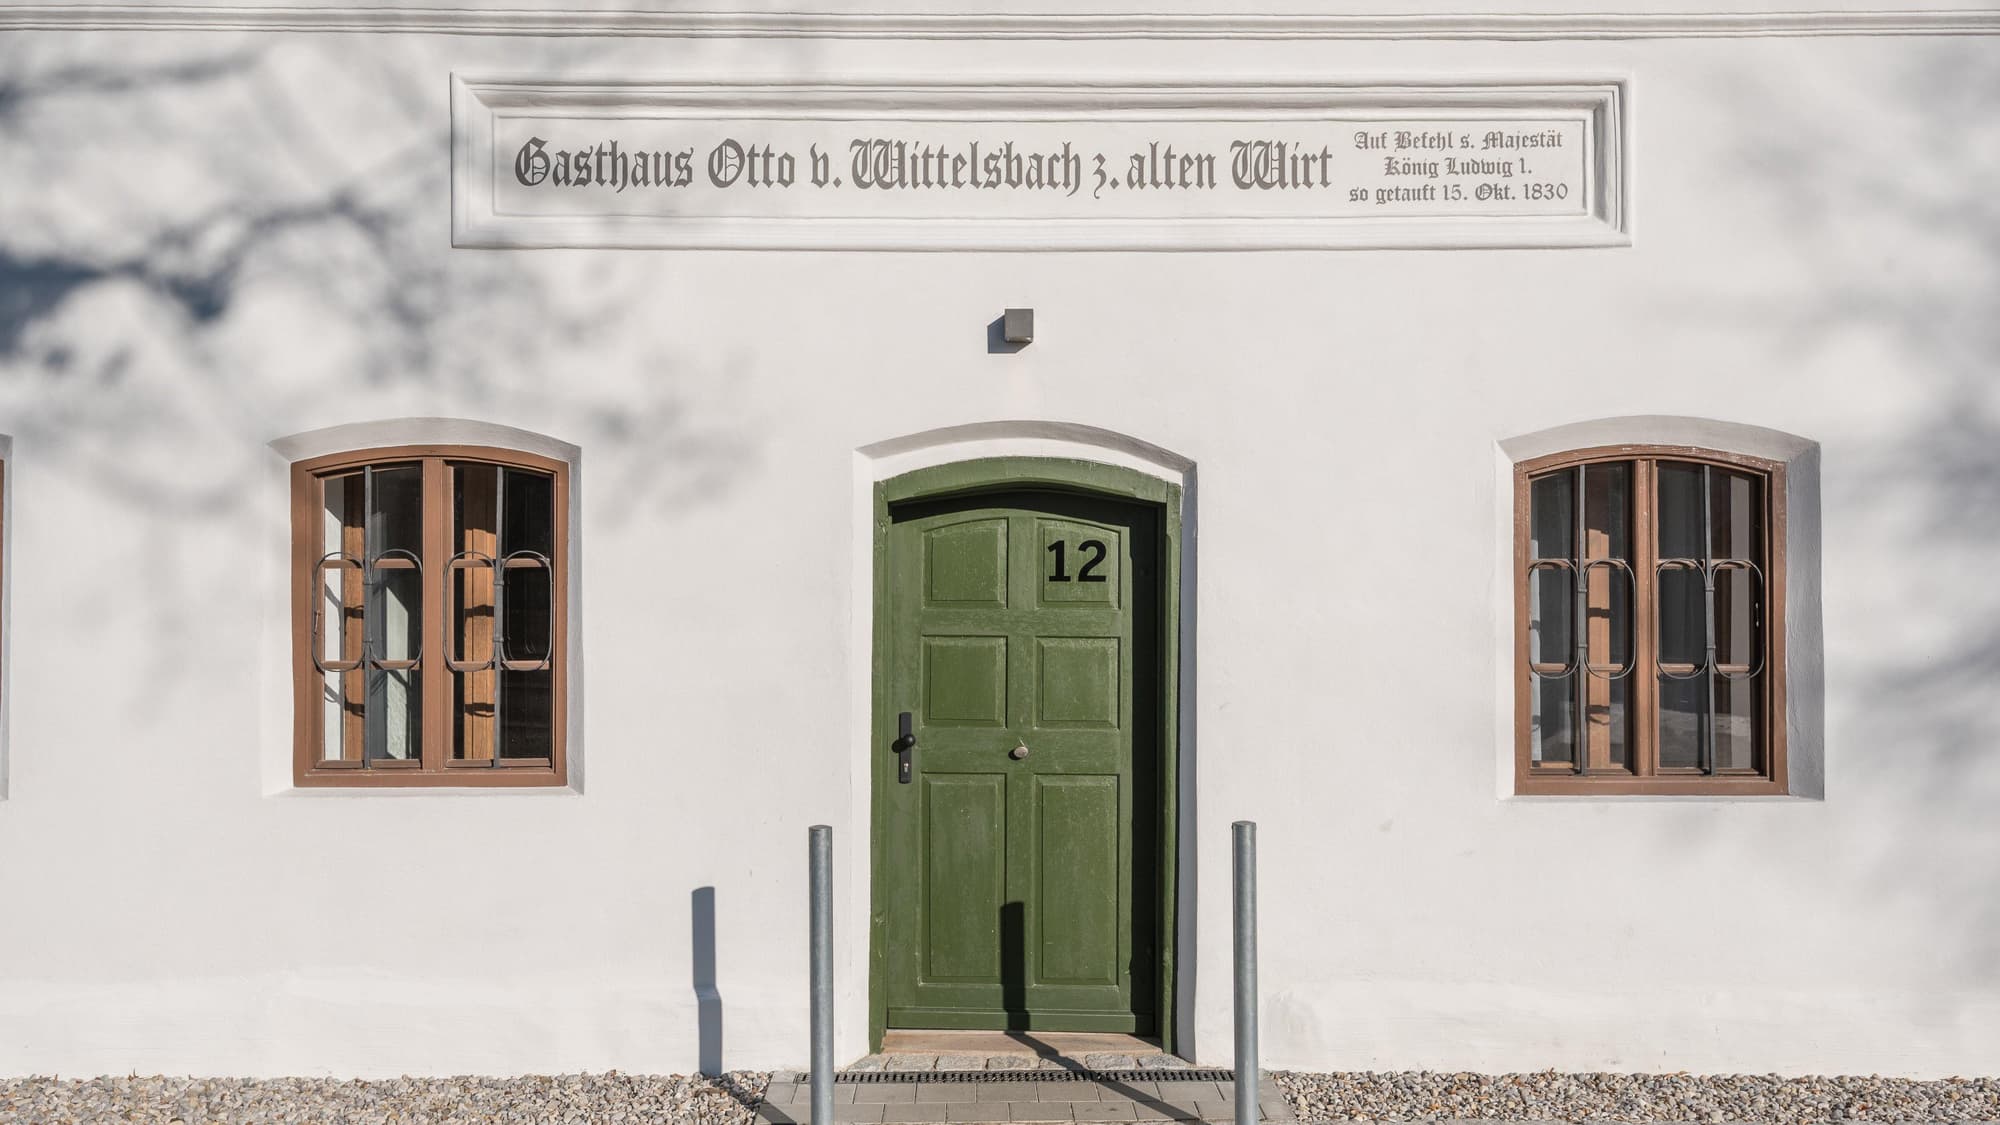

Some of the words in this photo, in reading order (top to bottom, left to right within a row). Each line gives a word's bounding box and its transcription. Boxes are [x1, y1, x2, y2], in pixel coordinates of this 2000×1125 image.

[1354, 131, 1388, 150] Auf
[1394, 131, 1454, 152] Befehl
[1460, 133, 1475, 149] s.
[1481, 130, 1563, 151] Majestät
[514, 136, 694, 194] Gasthaus
[707, 138, 795, 189] Otto
[809, 142, 842, 188] v.
[849, 138, 1081, 197] Wittelsbach
[1126, 141, 1217, 190] alten
[1229, 140, 1333, 190] Wirt
[1384, 156, 1440, 179] König
[1445, 157, 1513, 178] Ludwig
[1349, 187, 1369, 202] so
[1376, 183, 1436, 205] getauft
[1442, 184, 1468, 201] 15.
[1475, 183, 1516, 201] Okt.
[1523, 183, 1569, 201] 1830
[1047, 540, 1107, 582] 12
